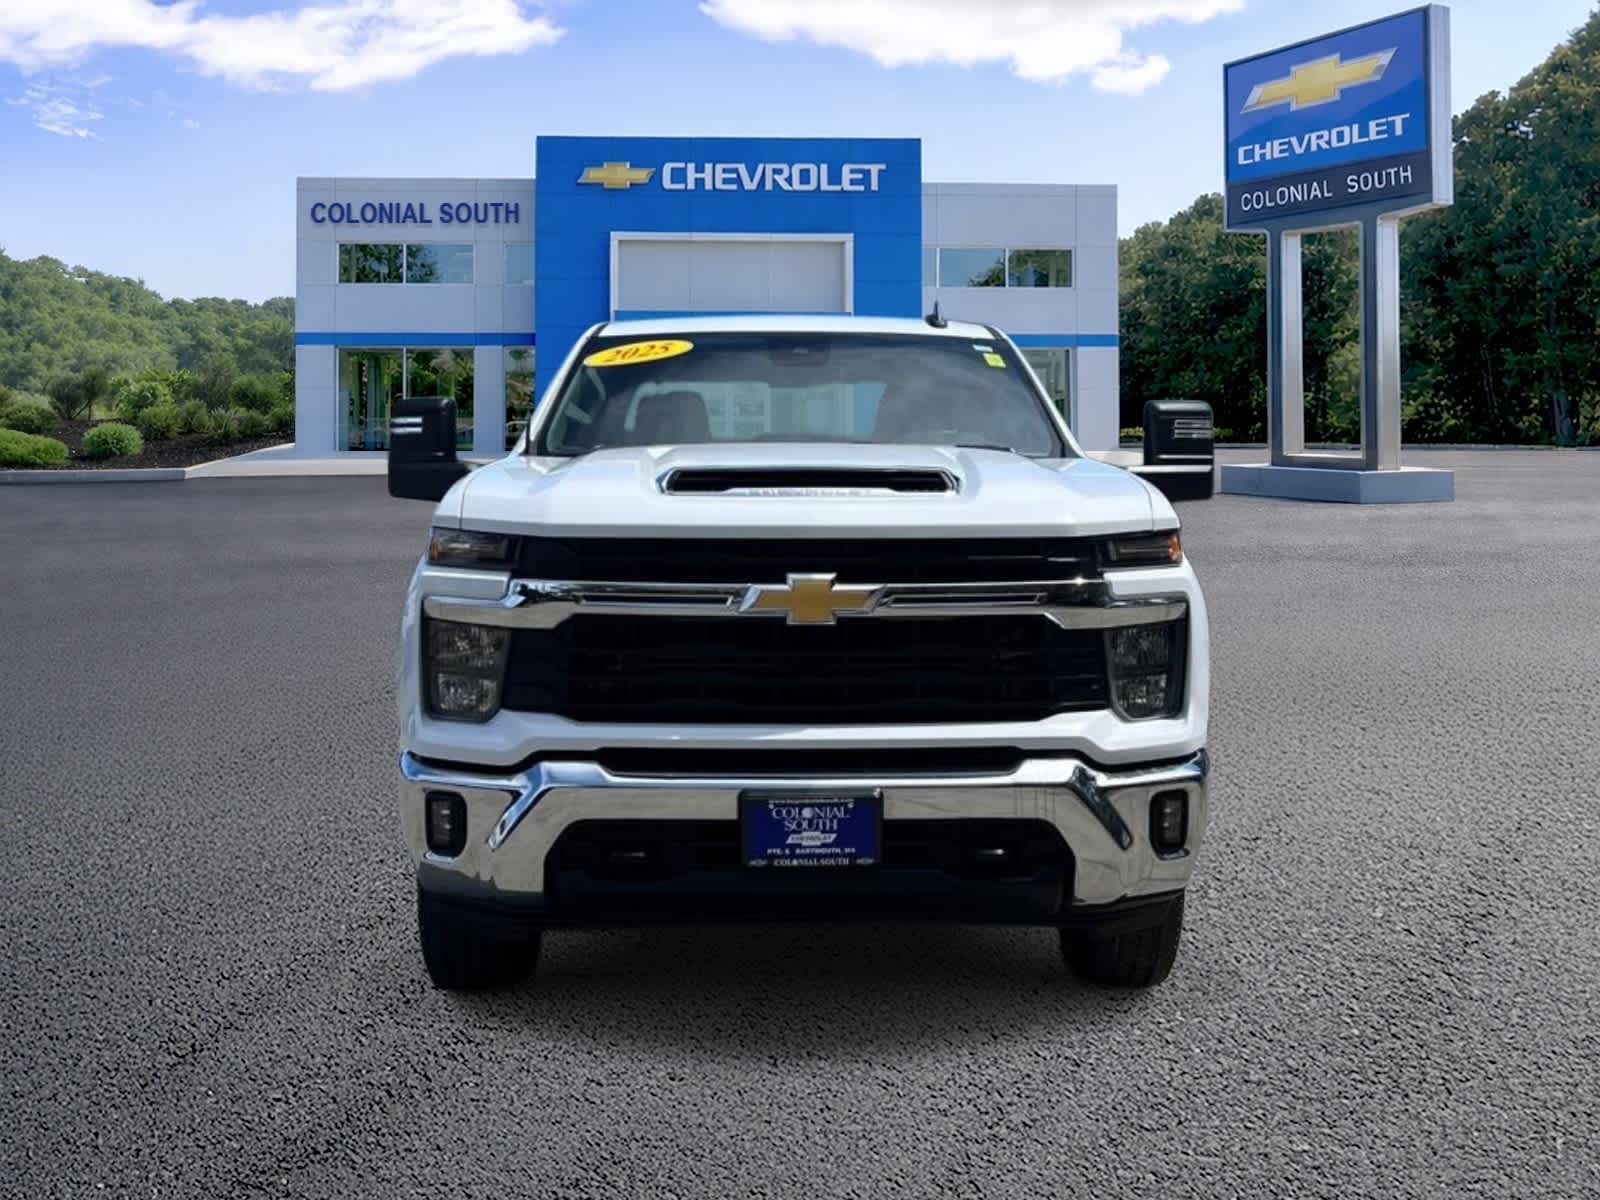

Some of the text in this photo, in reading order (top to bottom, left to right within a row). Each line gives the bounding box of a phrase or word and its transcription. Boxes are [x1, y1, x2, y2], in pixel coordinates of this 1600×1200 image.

[1237, 113, 1410, 165] CHEVROLET
[661, 162, 887, 192] CHEVROLET
[1240, 165, 1413, 211] COLONIAL SOUTH
[310, 203, 521, 225] COLONIAL SOUTH
[603, 342, 674, 363] 2025
[771, 807, 850, 820] COLONIAL
[784, 819, 838, 832] SOUTH
